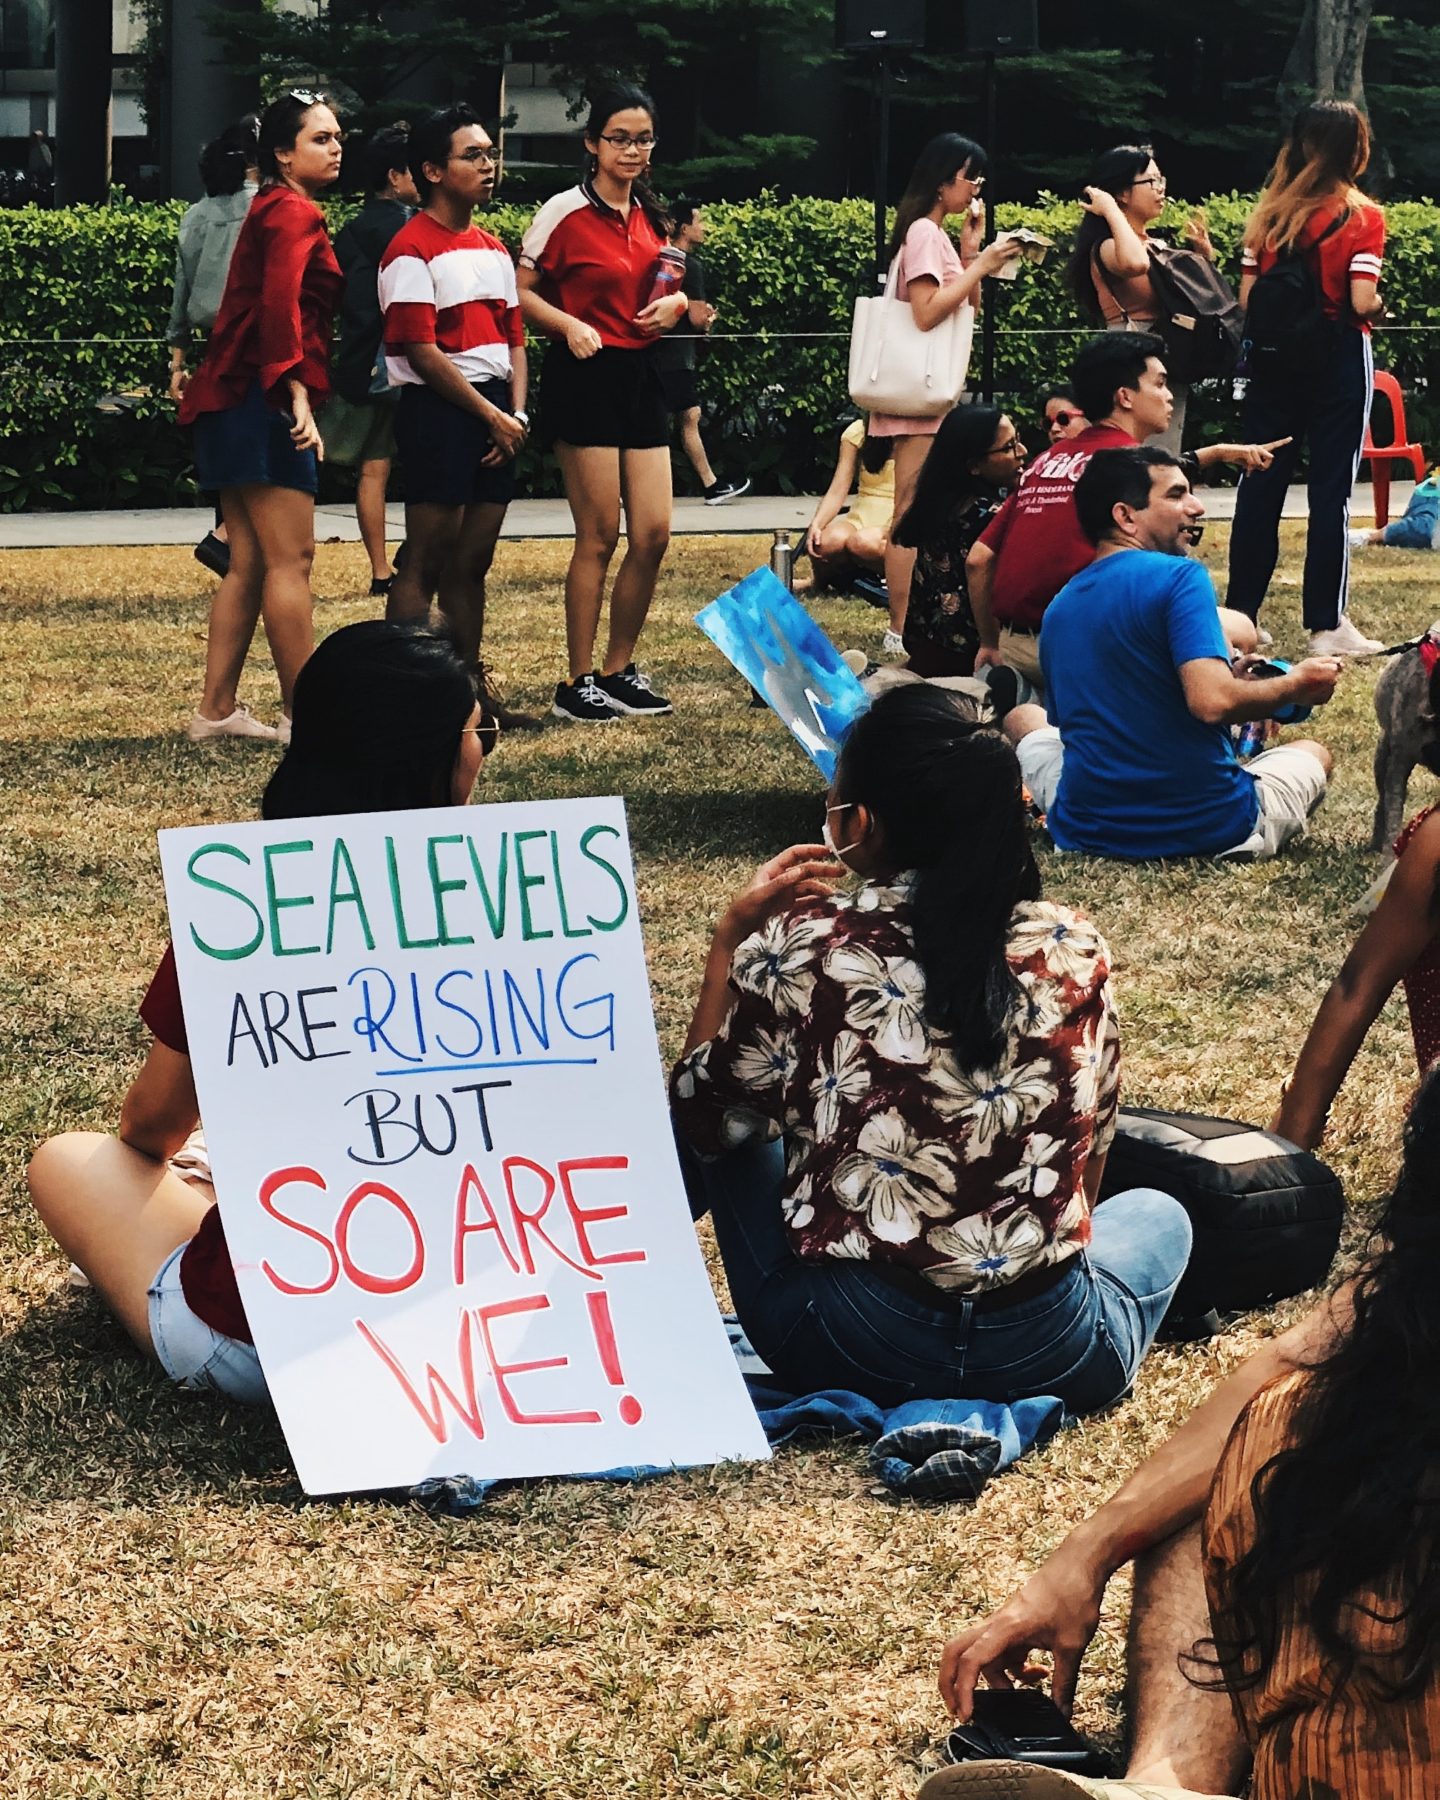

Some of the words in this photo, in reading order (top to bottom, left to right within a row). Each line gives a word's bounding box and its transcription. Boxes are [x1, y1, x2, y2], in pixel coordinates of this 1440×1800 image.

[186, 837, 376, 961] SEA
[384, 824, 629, 951] LEVELS
[227, 985, 352, 1068] ARE
[347, 953, 616, 1062] RISING
[343, 1080, 513, 1166] BUT
[258, 1165, 425, 1295] SO
[452, 1155, 647, 1286] ARE
[355, 1291, 646, 1444] WE!
